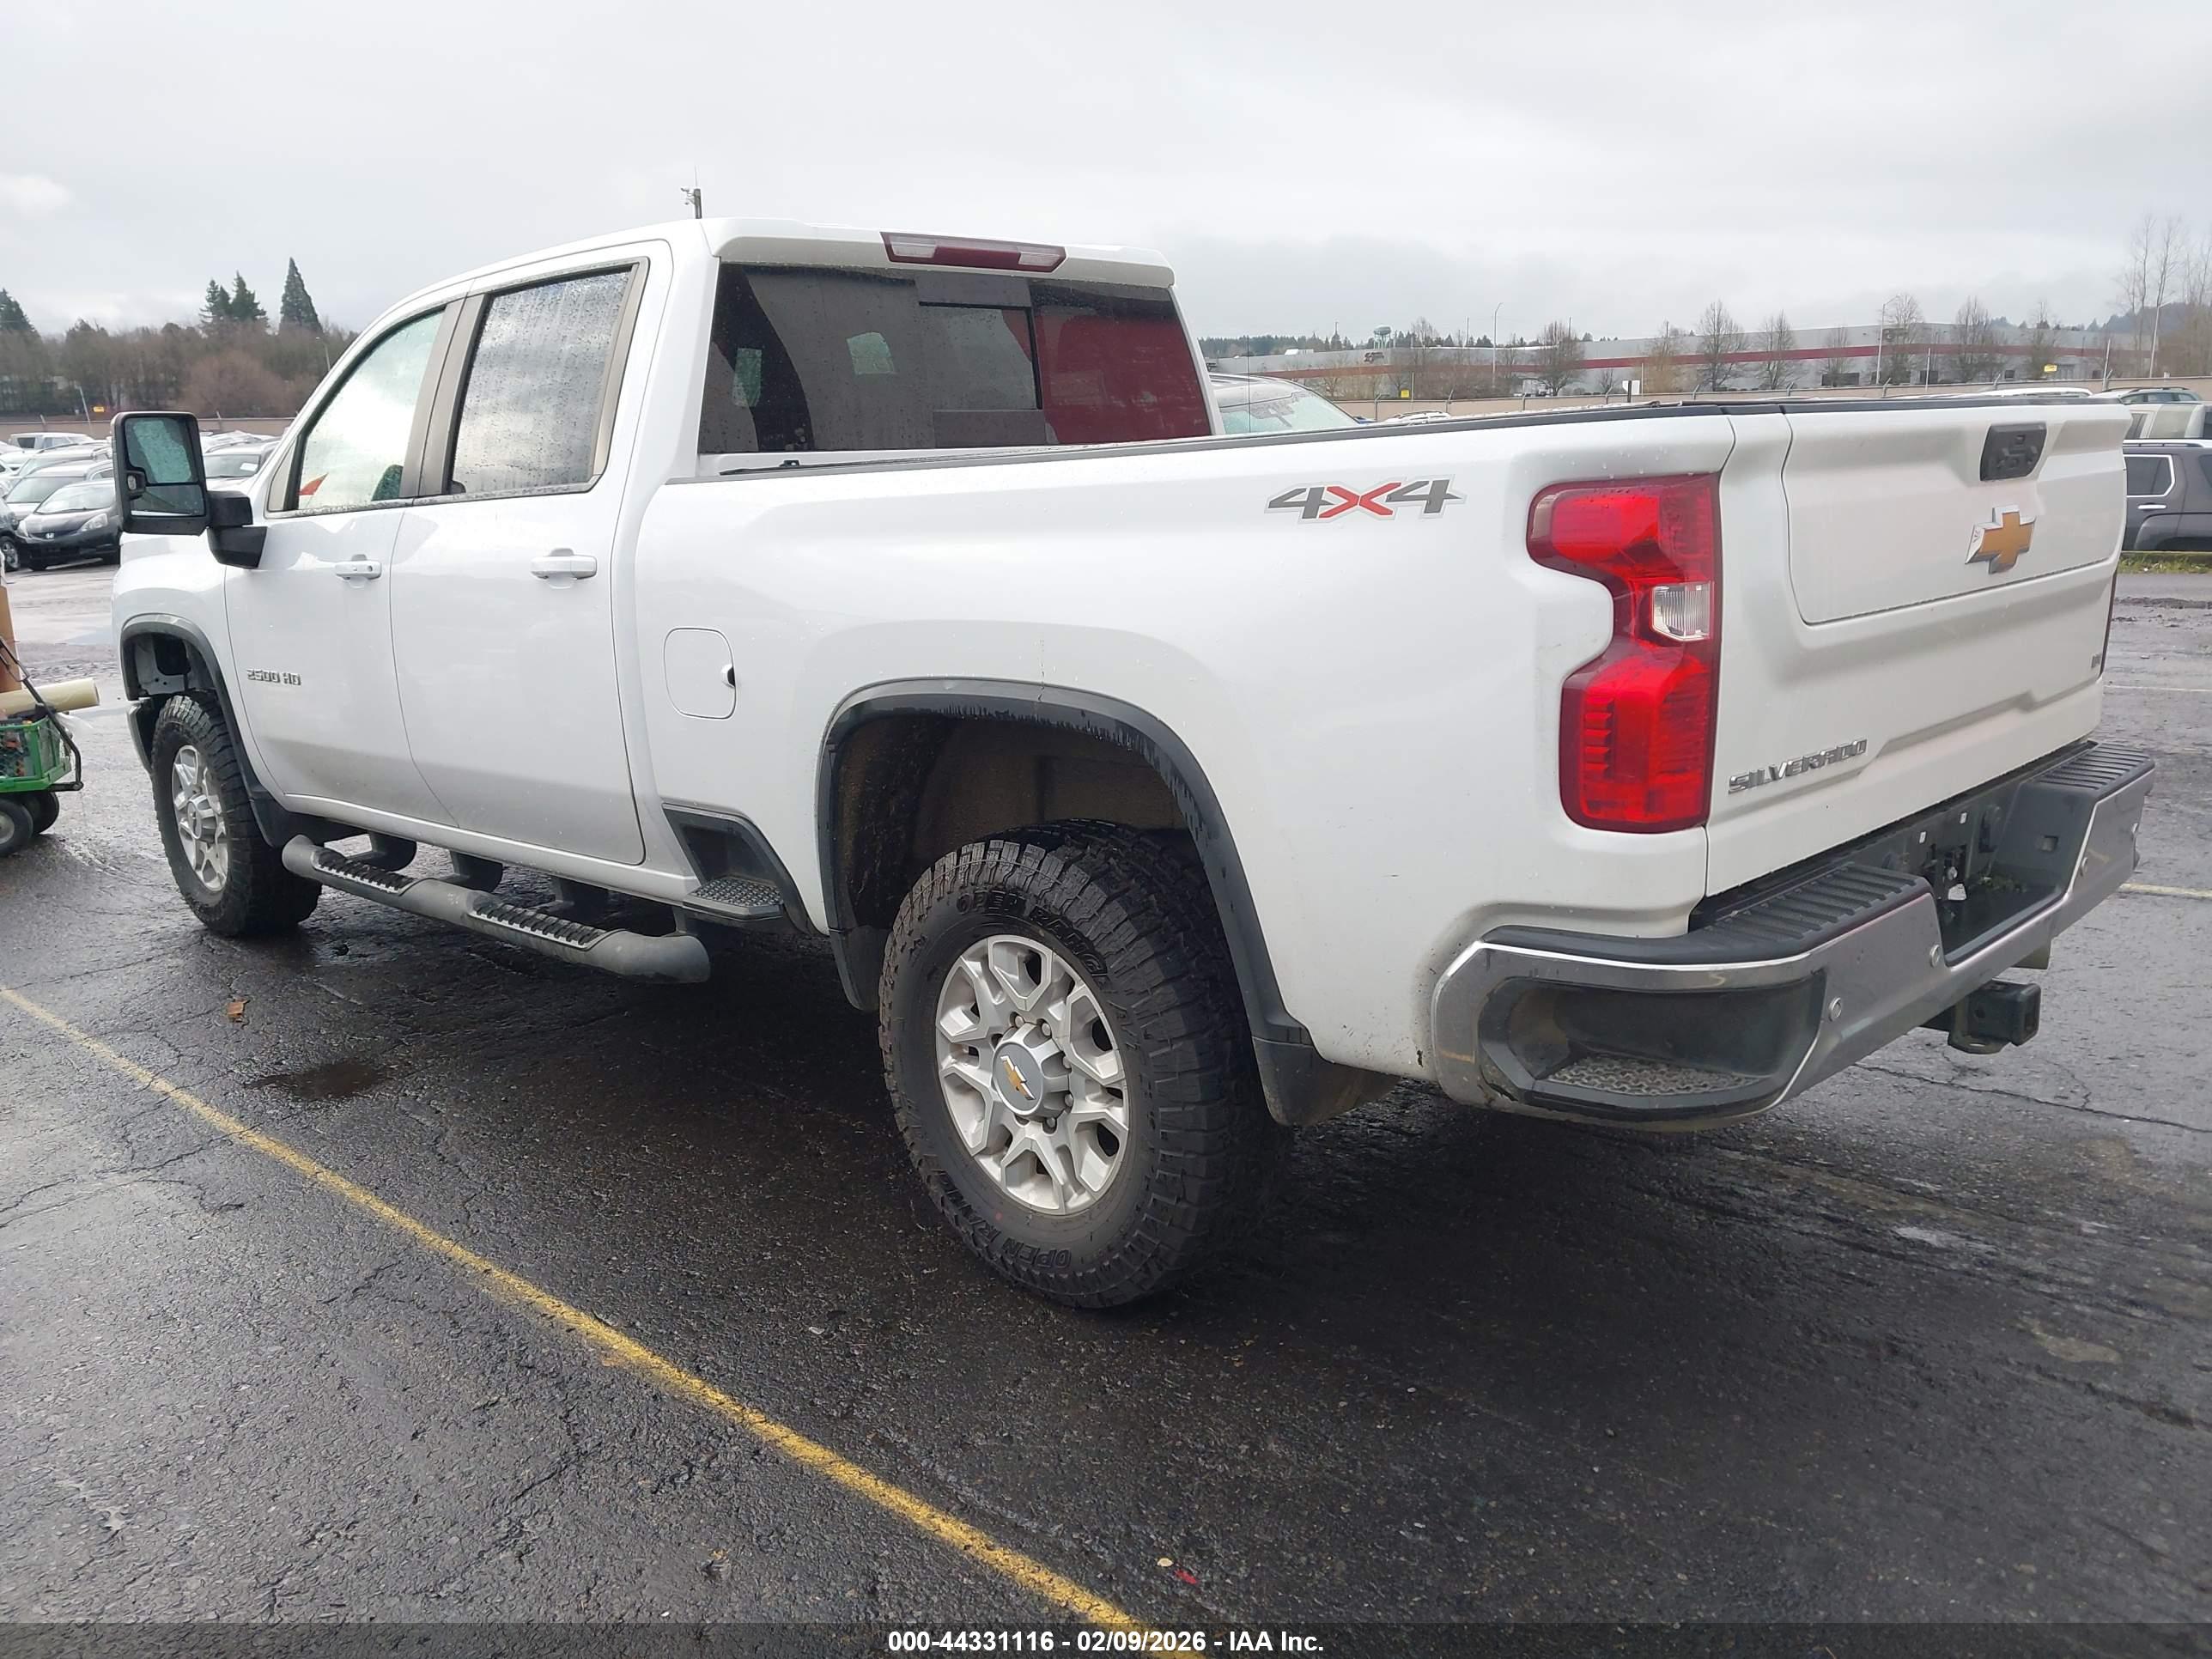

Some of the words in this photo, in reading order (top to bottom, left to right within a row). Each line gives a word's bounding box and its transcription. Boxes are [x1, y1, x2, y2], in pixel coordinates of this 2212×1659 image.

[246, 668, 281, 684] 2500
[282, 672, 302, 686] HD
[1728, 738, 1868, 795] SILVERADO
[1001, 1237, 1073, 1269] OPEN
